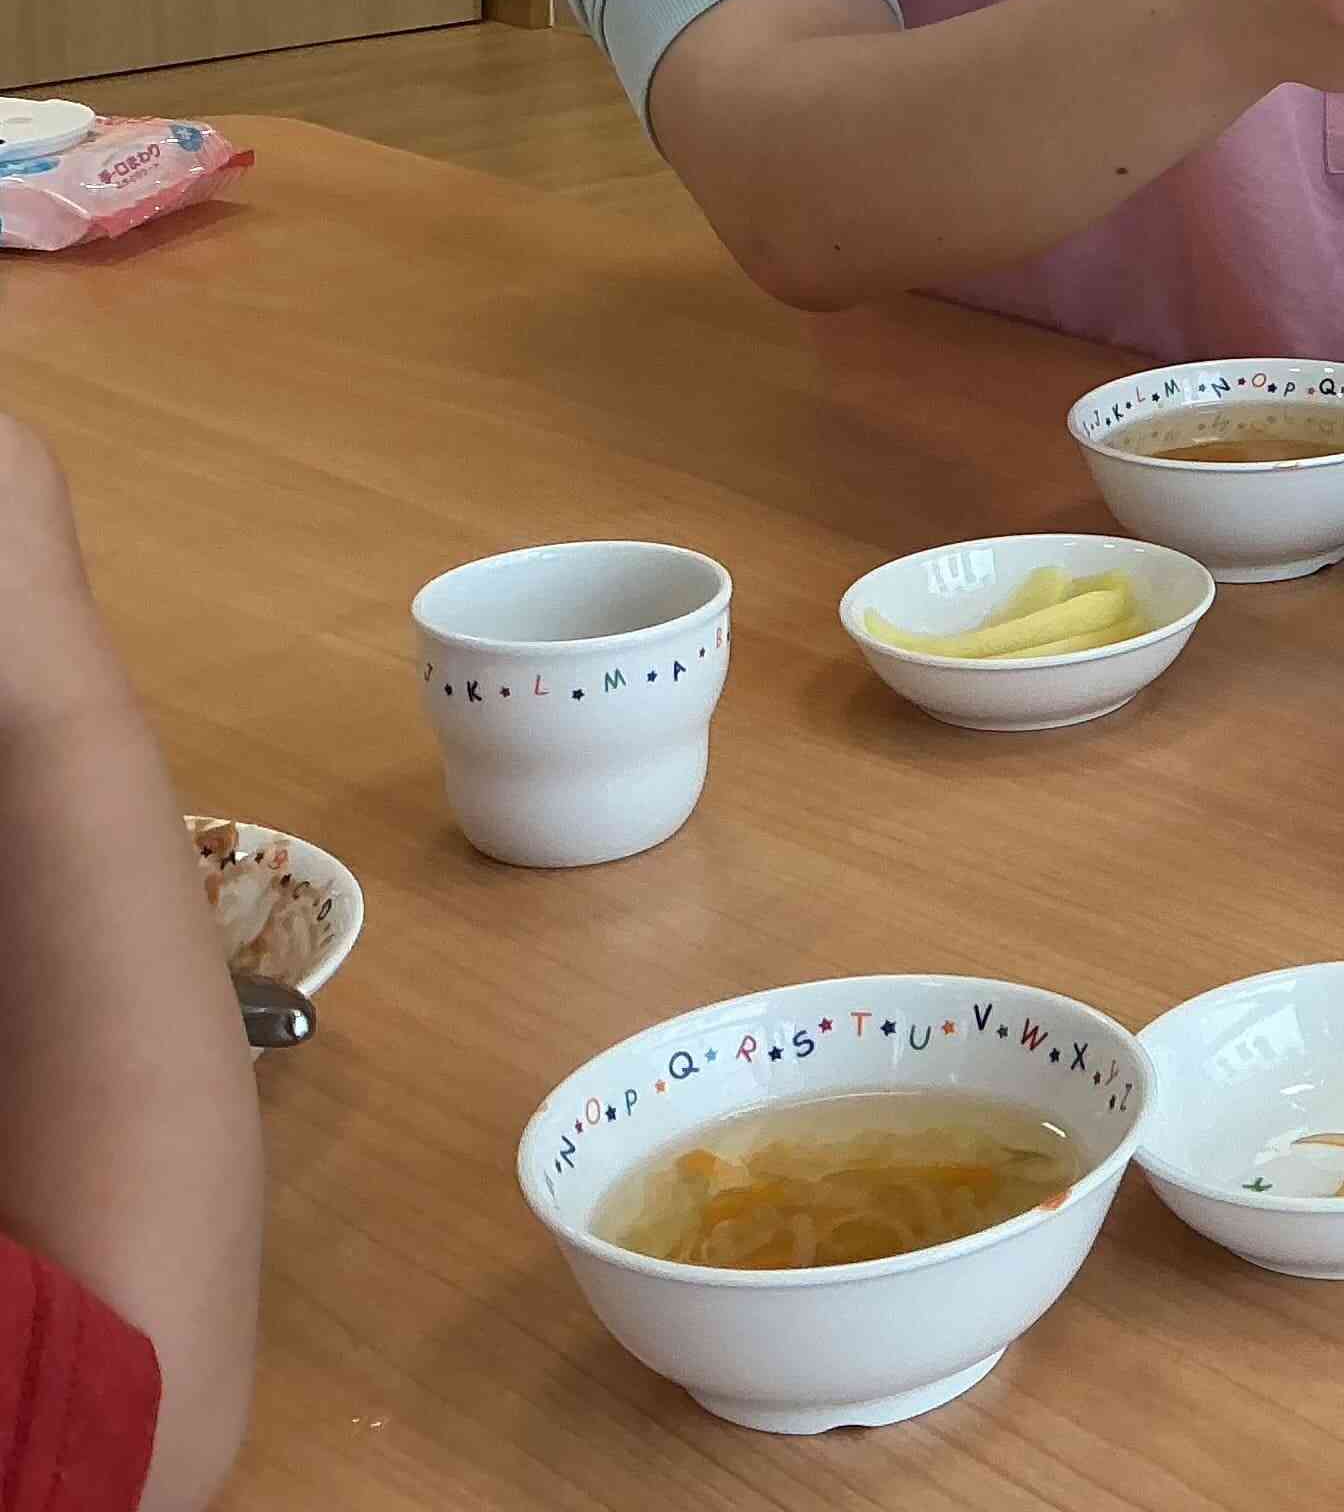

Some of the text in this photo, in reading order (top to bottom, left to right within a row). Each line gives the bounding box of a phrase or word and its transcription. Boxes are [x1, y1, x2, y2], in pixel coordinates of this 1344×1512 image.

[1112, 403, 1124, 422] K
[1136, 387, 1146, 403] L
[1164, 379, 1180, 398] M
[1211, 377, 1231, 399] N
[1252, 373, 1267, 388] O
[1284, 382, 1296, 397] P
[1319, 378, 1337, 396] Q
[467, 680, 482, 702] K
[535, 674, 551, 696] L
[604, 668, 626, 692] M
[674, 660, 687, 682] A
[560, 1135, 576, 1169] N
[585, 1097, 601, 1125] O
[624, 1088, 638, 1116] P
[668, 1050, 700, 1079] Q
[736, 1035, 757, 1062] R
[792, 1030, 814, 1057] S
[851, 1011, 872, 1037] T
[909, 1024, 931, 1050] U
[973, 1003, 992, 1031] V
[1020, 1017, 1048, 1051] W
[1070, 1043, 1088, 1071] X
